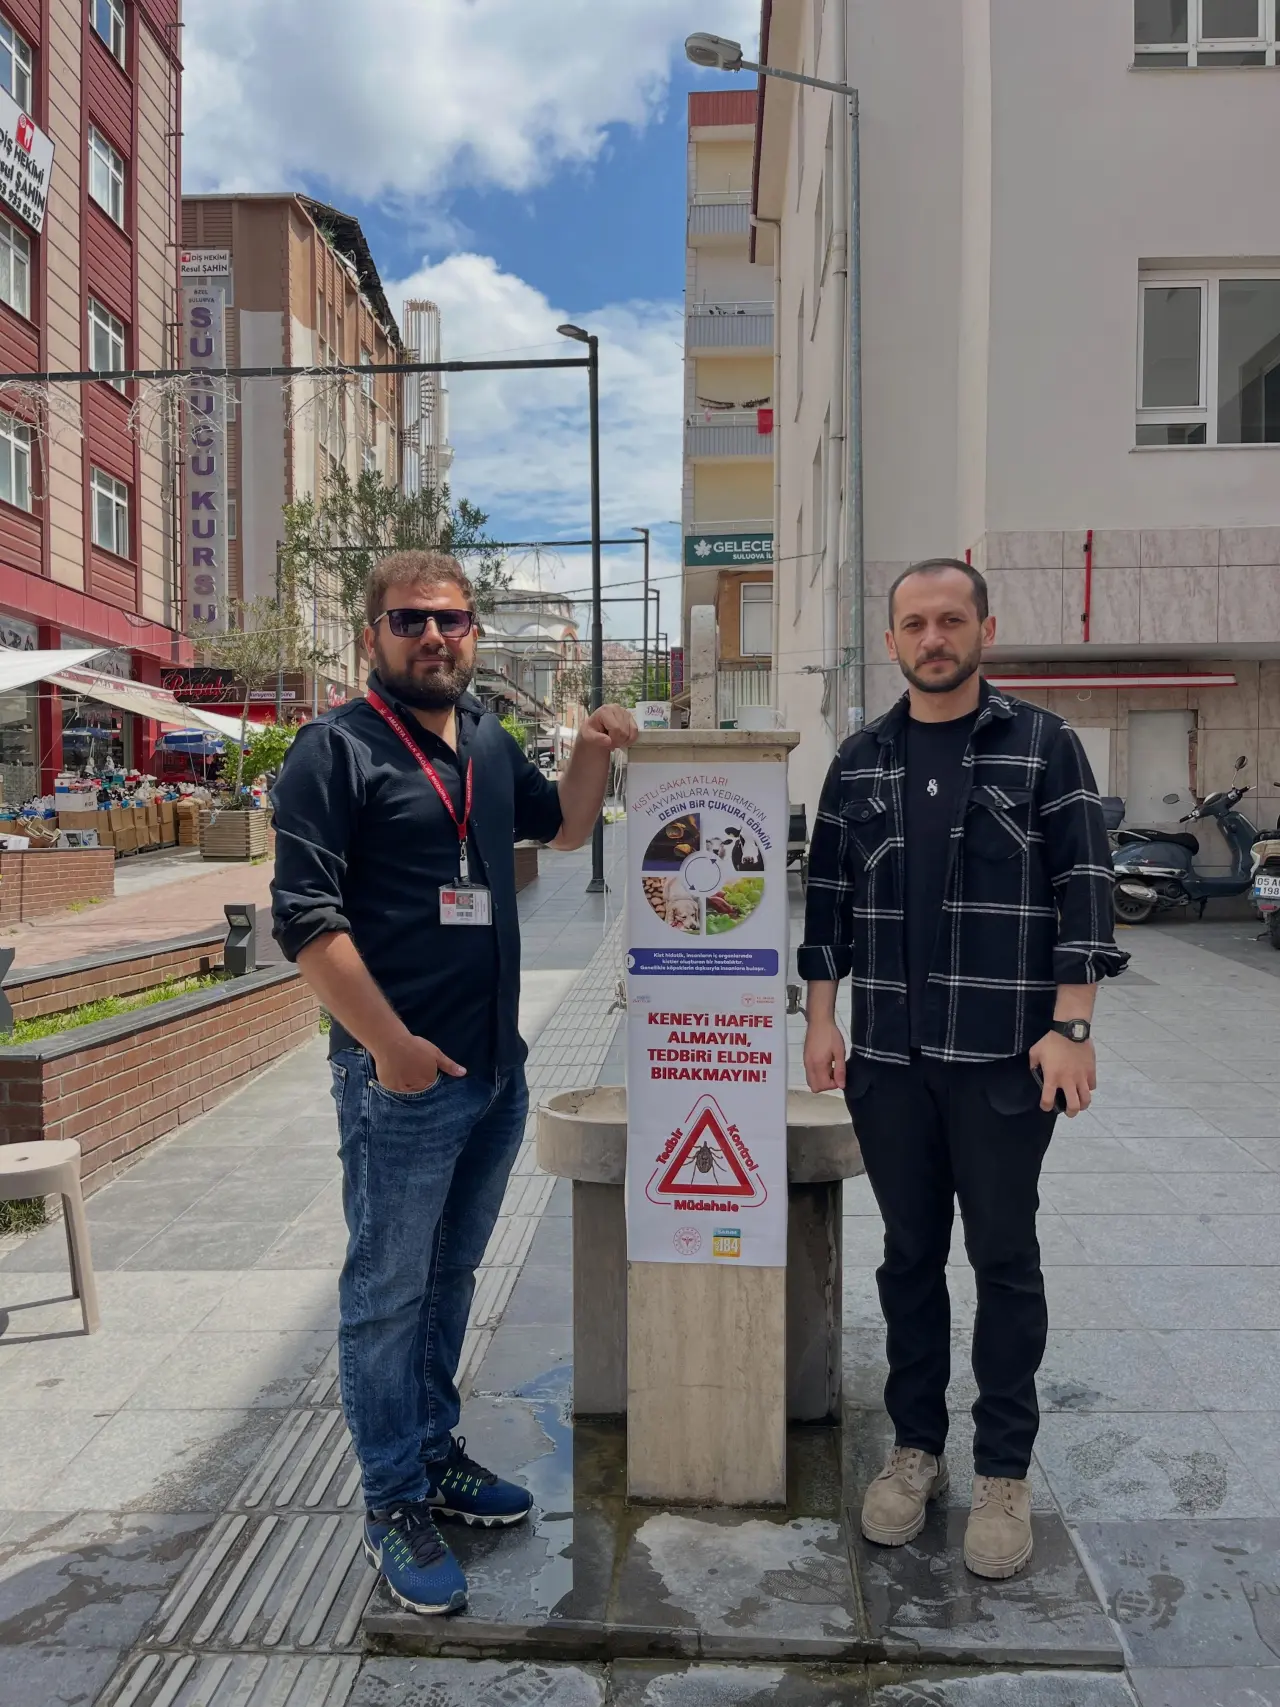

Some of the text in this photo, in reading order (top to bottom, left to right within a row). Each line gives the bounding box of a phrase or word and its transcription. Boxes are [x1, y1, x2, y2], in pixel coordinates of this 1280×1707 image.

[14, 144, 44, 185] HEKİMİ
[0, 161, 45, 212] sul ŞAHİN
[32, 212, 41, 227] 57
[192, 253, 227, 262] DİŞ HEKİMİ
[202, 263, 227, 274] ŞAHİN
[713, 540, 774, 552] GELECE
[659, 775, 728, 793] SAKATATLARI
[646, 787, 710, 816] HAYVANLARA
[658, 800, 773, 850] DERİN BİR ÇUKURA GÖMÜN
[1257, 877, 1280, 886] 05 A
[1263, 887, 1279, 895] 198
[667, 1031, 752, 1047] ALMAYIN,
[717, 1051, 772, 1065] ELDEN
[651, 1067, 767, 1083] BIRAKMAYIN!
[656, 1127, 683, 1165] Tedbir
[726, 1124, 759, 1172] Kontrol
[674, 1200, 740, 1213] Müdahale
